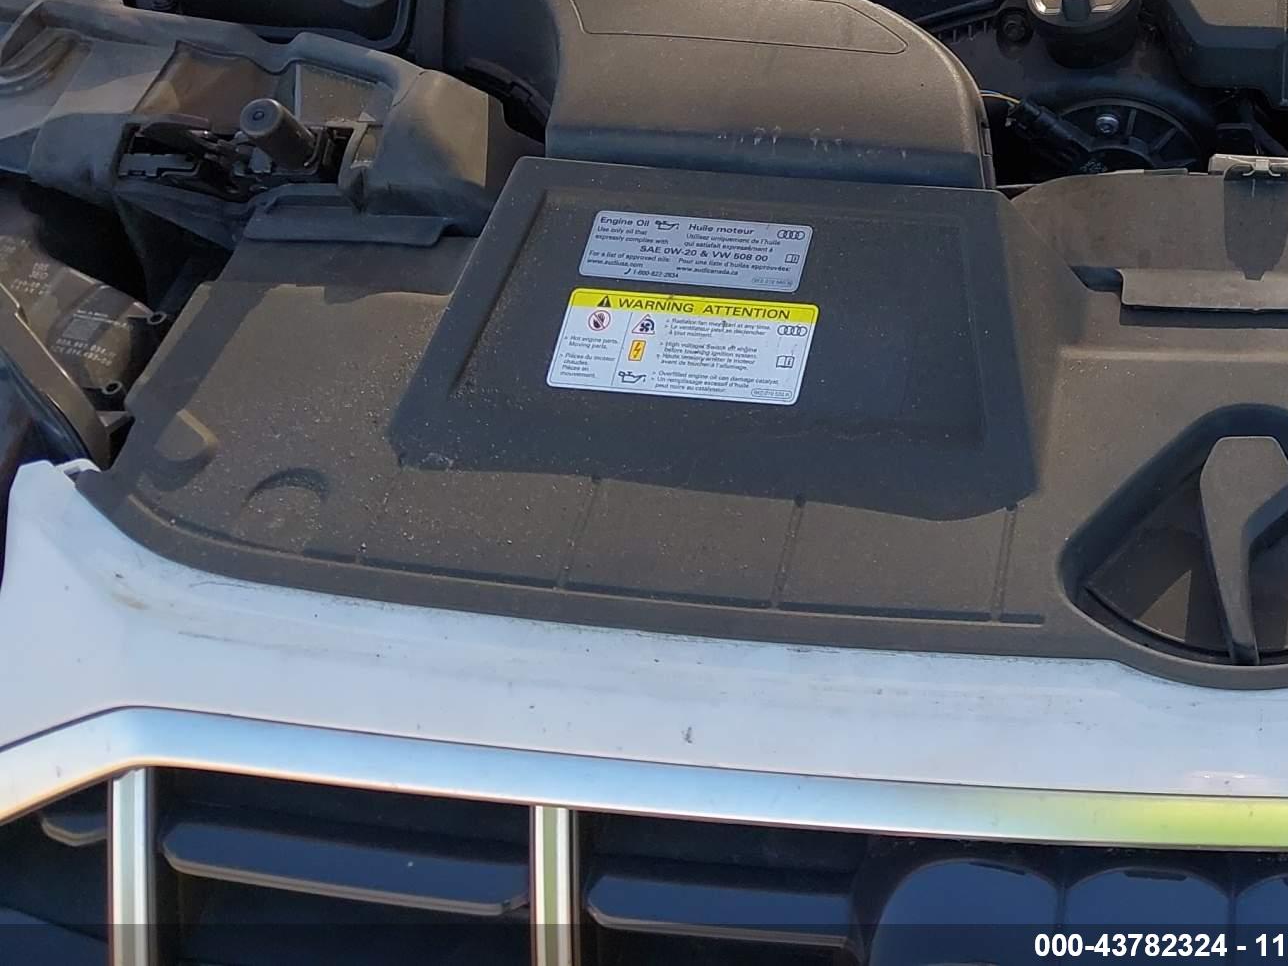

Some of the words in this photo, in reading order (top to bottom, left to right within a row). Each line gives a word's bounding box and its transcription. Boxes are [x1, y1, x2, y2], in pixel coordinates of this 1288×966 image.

[600, 217, 633, 226] Engine
[636, 219, 650, 227] Oil
[688, 224, 714, 232] Huile
[716, 226, 754, 235] moteur
[595, 234, 624, 242] expressly
[625, 236, 653, 244] complies
[711, 235, 749, 244] uniquement
[625, 254, 656, 262] approved
[640, 245, 662, 253] SAE
[664, 247, 698, 256] 0W-20
[699, 249, 708, 257] &
[712, 250, 732, 259] VW
[734, 252, 752, 260] 508
[755, 254, 768, 262] 00
[587, 259, 643, 268] www.audiusa.com
[708, 259, 722, 267] liste
[724, 260, 749, 269] d'huiles
[751, 263, 791, 272] approuvées:
[676, 267, 738, 276] www.audicanada.ca
[618, 298, 694, 313] WARNING
[702, 305, 791, 320] ATTENTION
[688, 372, 708, 380] engine
[730, 376, 754, 384] damage
